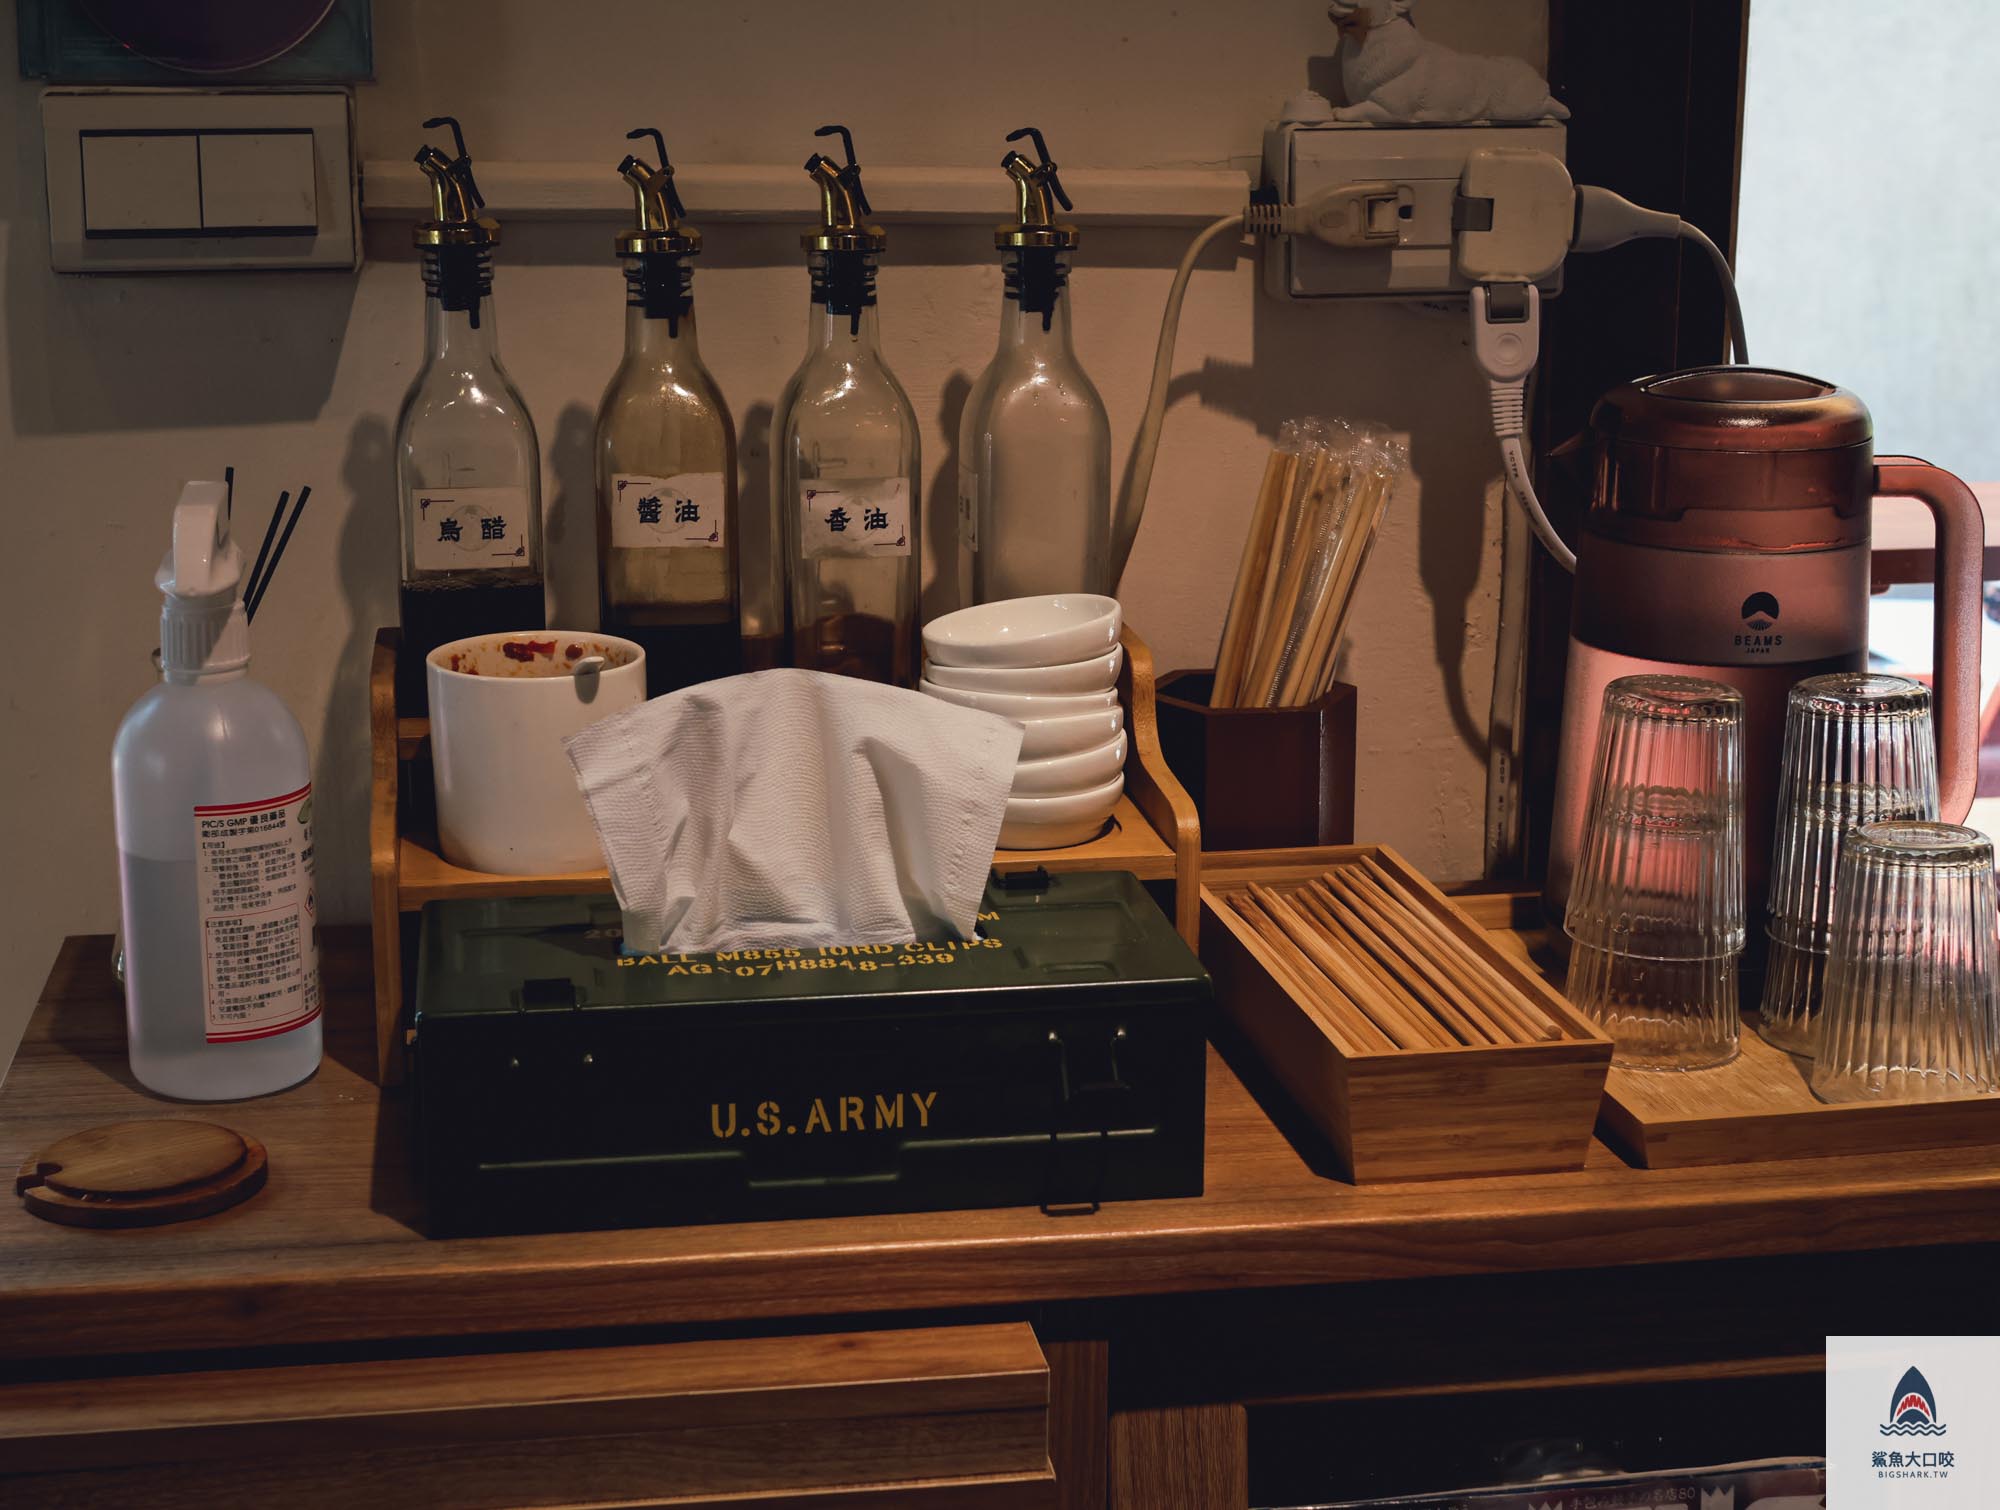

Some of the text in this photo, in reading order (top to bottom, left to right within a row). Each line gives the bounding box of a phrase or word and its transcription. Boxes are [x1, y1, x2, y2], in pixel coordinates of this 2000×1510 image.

[637, 497, 701, 525] 醬油
[824, 506, 890, 532] 香油
[1734, 635, 1783, 646] BEAMS
[202, 819, 225, 829] PIC/S
[226, 818, 248, 827] GMP
[616, 952, 697, 967] BALL
[904, 938, 1003, 952] CLIPS
[711, 1092, 937, 1138] U.S.ARMY
